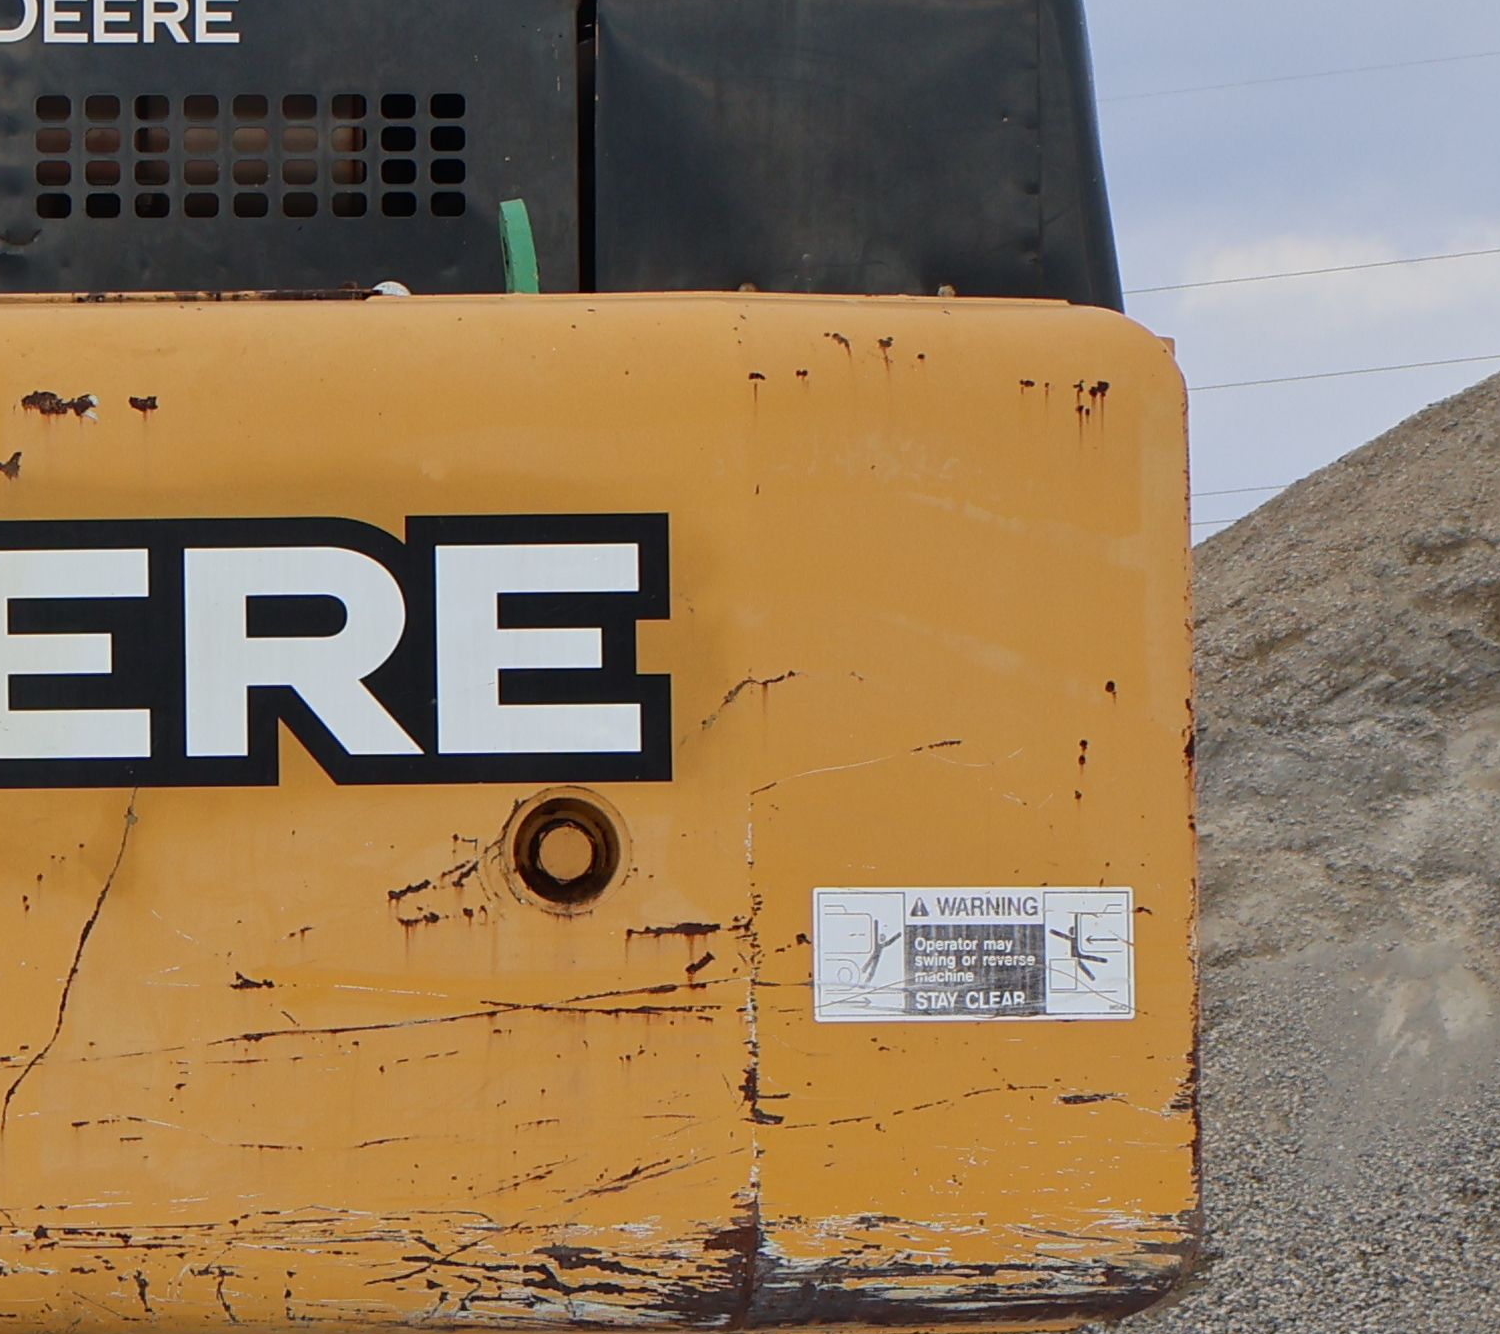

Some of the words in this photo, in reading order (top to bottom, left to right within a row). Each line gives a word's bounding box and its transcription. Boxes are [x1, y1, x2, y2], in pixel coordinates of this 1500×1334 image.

[936, 896, 1039, 917] WARNING
[914, 937, 978, 953] Operator
[983, 939, 1013, 953] may
[914, 953, 956, 969] swing
[961, 955, 977, 966] or
[982, 954, 1036, 967] reverse
[914, 967, 975, 983] machine
[914, 991, 958, 1010] STAY
[965, 991, 1026, 1009] CLEAR
